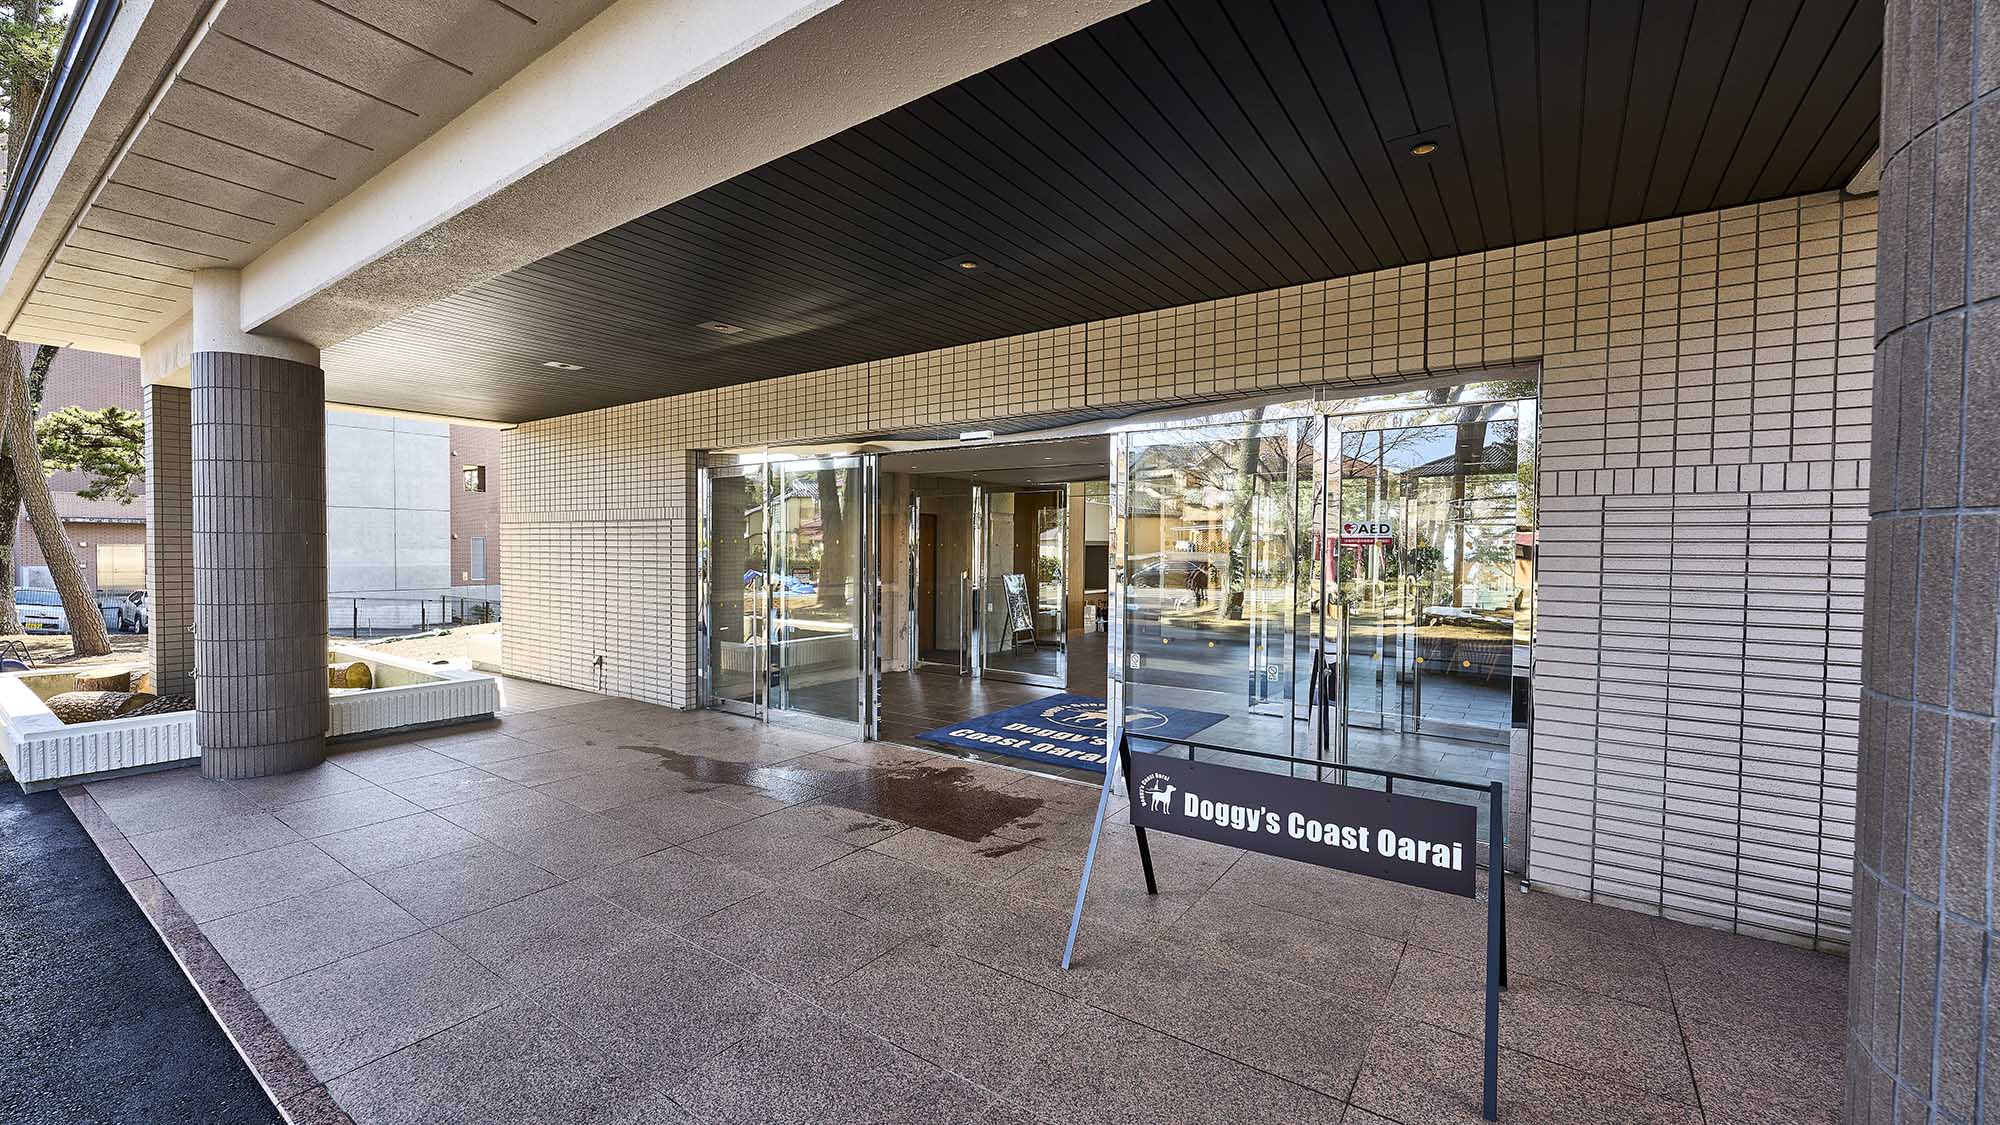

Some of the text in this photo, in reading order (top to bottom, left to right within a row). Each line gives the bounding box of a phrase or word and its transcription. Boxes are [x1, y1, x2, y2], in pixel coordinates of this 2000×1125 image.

[1358, 524, 1390, 534] AED
[948, 728, 1030, 748] Coast
[1002, 722, 1106, 746] Doggy's
[1184, 791, 1463, 871] Doggy's Coast Oarai
